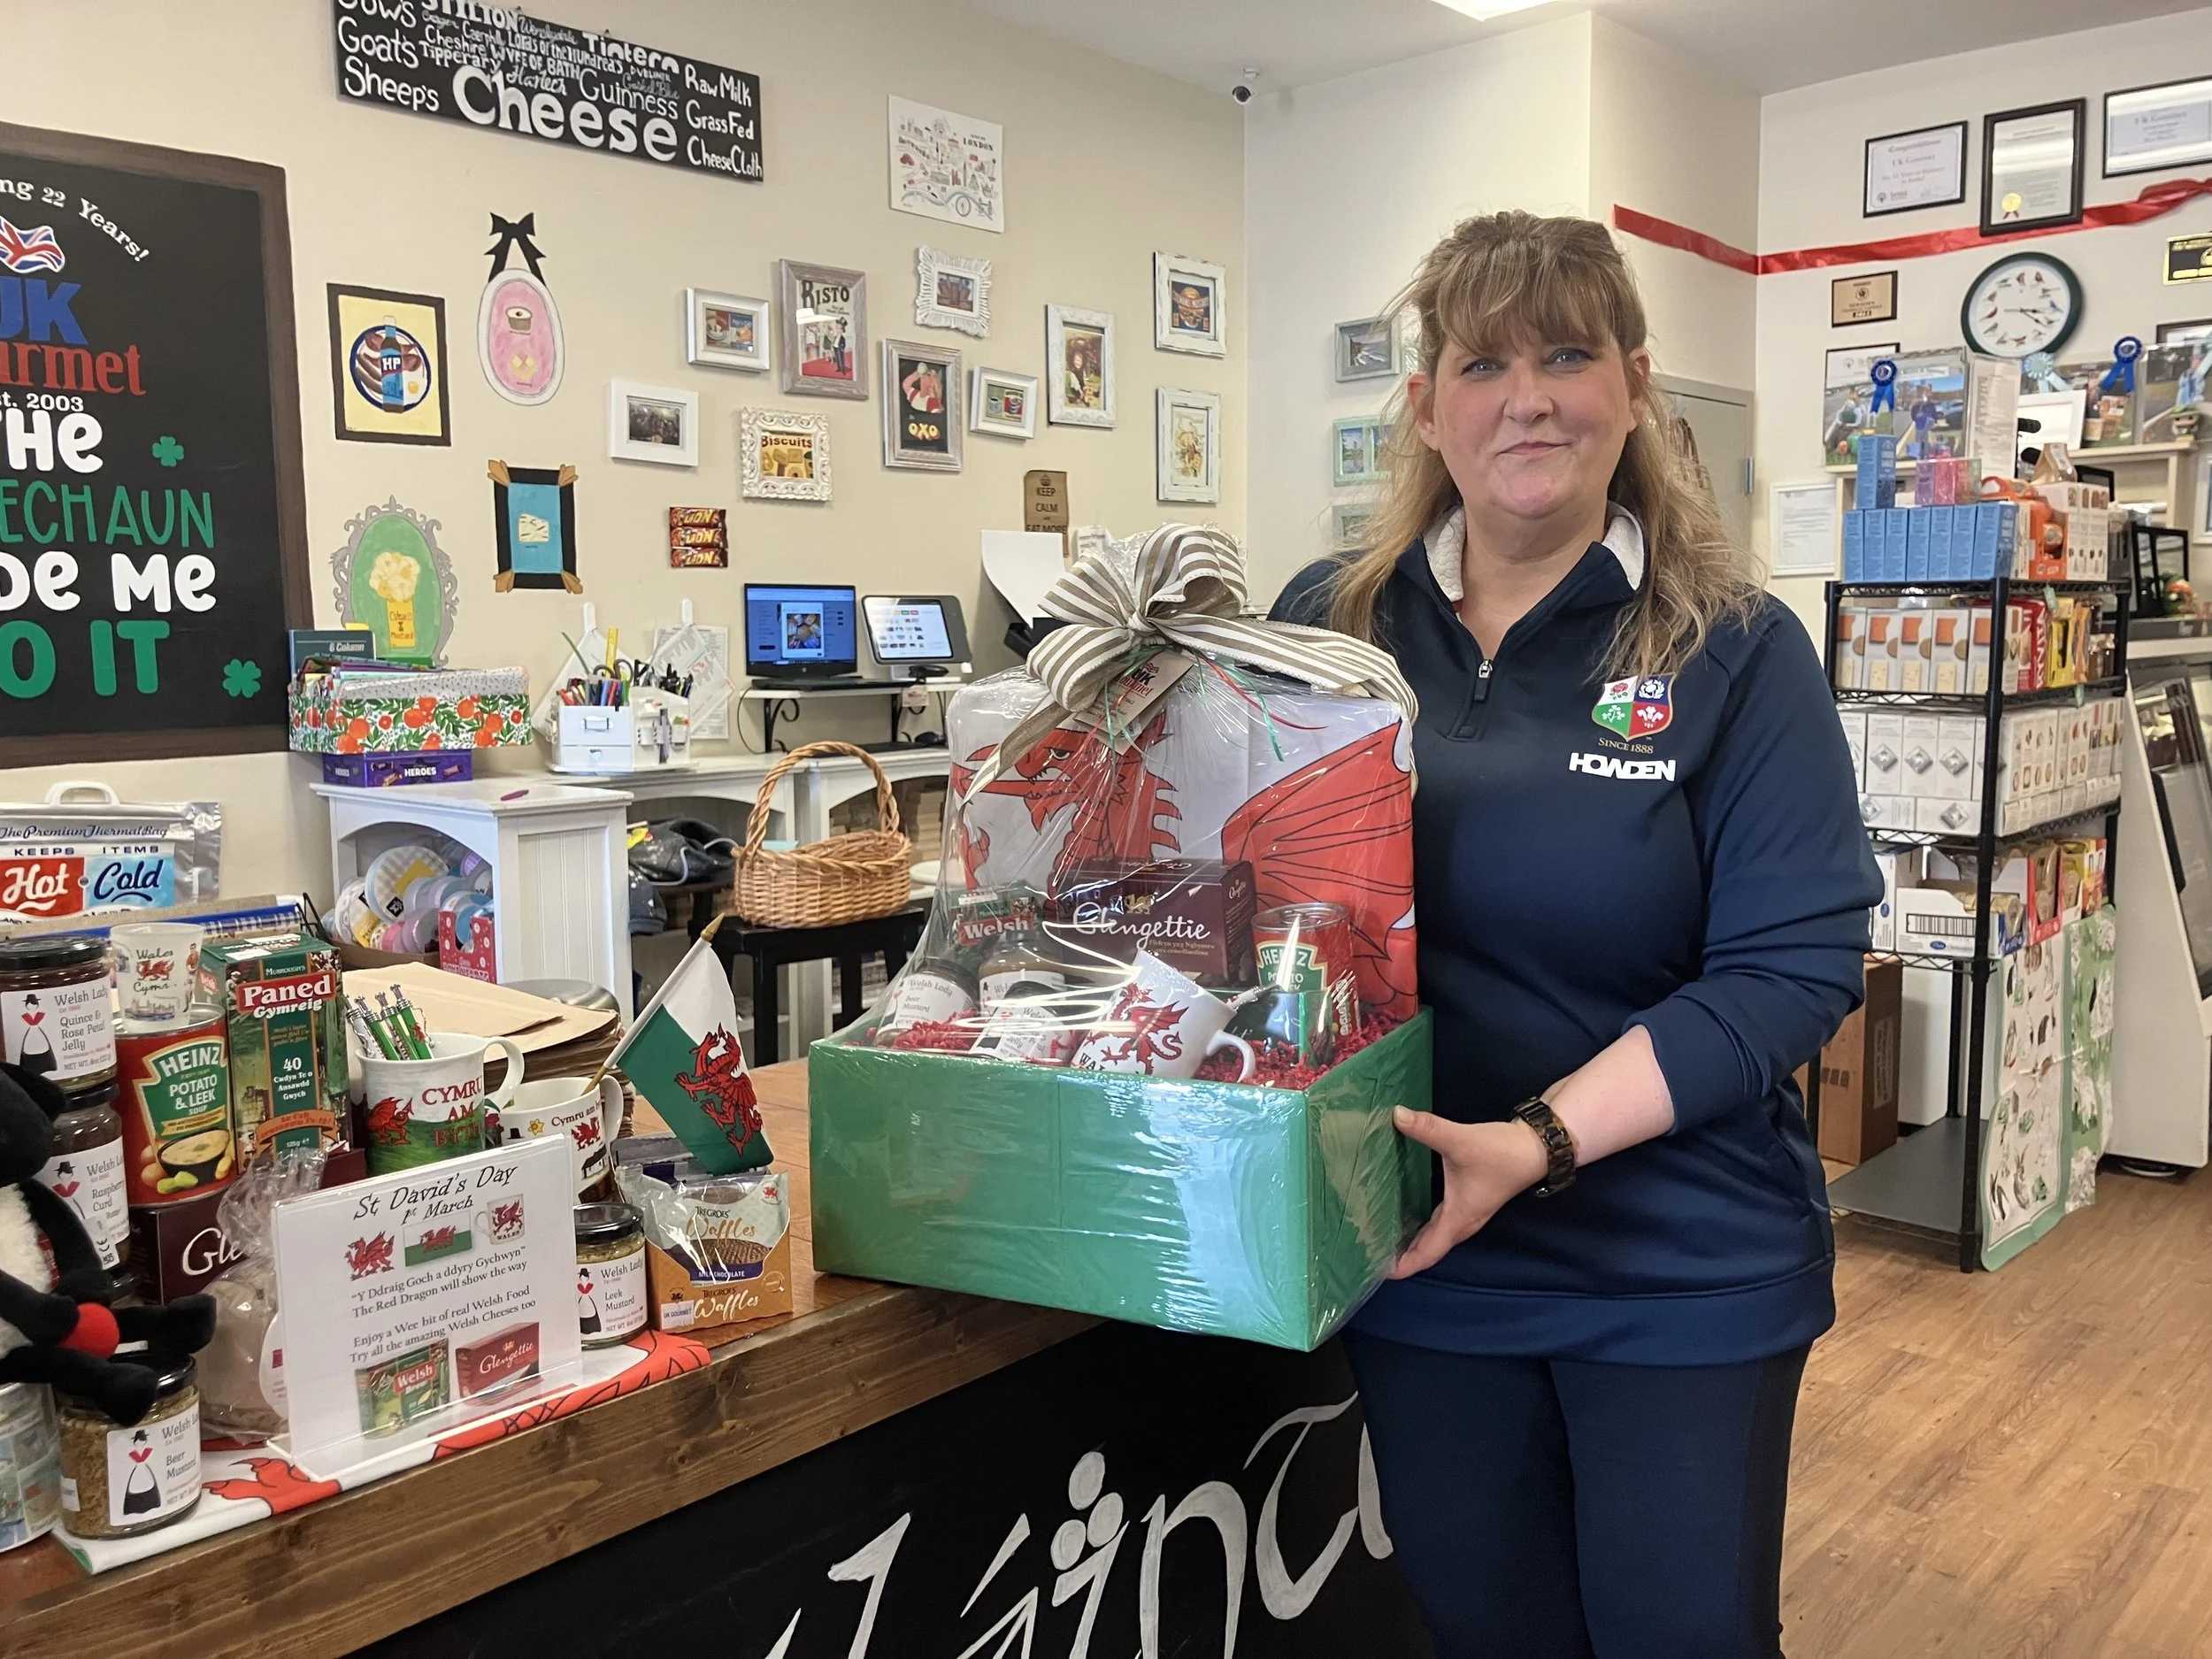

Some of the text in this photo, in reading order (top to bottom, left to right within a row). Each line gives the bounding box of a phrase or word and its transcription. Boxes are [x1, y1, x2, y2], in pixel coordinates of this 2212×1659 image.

[338, 15, 419, 69] Goat's
[425, 24, 485, 57] Cheshire
[419, 40, 501, 74] Tipperary
[582, 32, 680, 74] Tintern
[529, 55, 580, 81] OF BATH
[344, 56, 440, 111] Sheep's
[579, 67, 679, 120] Guinness
[685, 63, 752, 108] Raw Milk
[452, 64, 679, 162] Cheese
[41, 186, 66, 209] 22
[78, 197, 150, 262] Years!
[801, 280, 850, 314] BISTO
[381, 357, 402, 371] HP
[27, 392, 84, 411] 2003
[760, 434, 813, 448] Biscuits
[908, 421, 941, 441] OXO
[1035, 488, 1056, 496] KEEP
[684, 510, 713, 524] LION
[1035, 503, 1058, 512] CALM
[686, 530, 716, 543] LION
[686, 551, 715, 565] LION
[90, 619, 170, 696] IT
[329, 642, 365, 653] 6 Column
[1598, 737, 1654, 754] SINCE 1888
[404, 767, 437, 777] HEROES
[1569, 752, 1676, 782] HOWDEN
[0, 826, 23, 839] The
[23, 825, 88, 840] Premium
[14, 845, 159, 856] KEEPS ITEMS
[2, 859, 164, 905] Hot Cold
[964, 917, 1029, 940] Welsh
[1072, 901, 1211, 951] Glengettie
[55, 985, 109, 1007] Welsh Lady
[242, 974, 332, 1007] Paned
[909, 979, 954, 997] Welsh Lady
[253, 998, 323, 1019] Gymreig
[902, 1003, 931, 1014] Mustard
[60, 1015, 93, 1028] Quince
[61, 1020, 105, 1040] Rose Petal
[62, 1040, 87, 1052] Jelly
[159, 1047, 220, 1077] HEINZ
[283, 1057, 302, 1071] 40
[169, 1073, 218, 1097] POTATO
[277, 1079, 311, 1092] Ansawdd
[421, 1075, 483, 1105] CYMRU
[175, 1088, 217, 1110] & LEEK
[282, 1091, 306, 1101] Gwych
[188, 1103, 209, 1116] SOUP
[448, 1102, 474, 1122] AM
[551, 1110, 585, 1126] Cymru
[87, 1157, 115, 1177] Welsh
[353, 1165, 519, 1221] St David's Day
[93, 1197, 112, 1212] Curd
[422, 1194, 474, 1221] March
[695, 1206, 730, 1219] TREGROES
[496, 1231, 520, 1240] WALES
[687, 1217, 757, 1243] Waffles
[601, 1257, 644, 1279] Welsh Lady
[352, 1260, 527, 1318] The Red Dragon will show the way
[368, 1279, 405, 1300] Ddraig
[406, 1272, 434, 1288] Goch
[443, 1262, 474, 1278] ddyry
[604, 1289, 623, 1301] Leek
[605, 1294, 635, 1311] Mustard
[702, 1287, 736, 1298] TREGROES
[694, 1289, 759, 1321] Waffles
[353, 1331, 385, 1348] Enjoy
[395, 1322, 419, 1334] Wee
[422, 1312, 438, 1325] bit
[439, 1310, 449, 1322] of
[451, 1303, 471, 1318] real
[472, 1294, 504, 1310] Welsh
[505, 1285, 531, 1302] Food
[349, 1299, 537, 1363] Try all the amazing Welsh Cheeses too
[397, 1365, 434, 1387] Welsh
[162, 1417, 192, 1440] Welsh
[166, 1451, 186, 1466] Beer
[167, 1454, 197, 1479] Mustard
